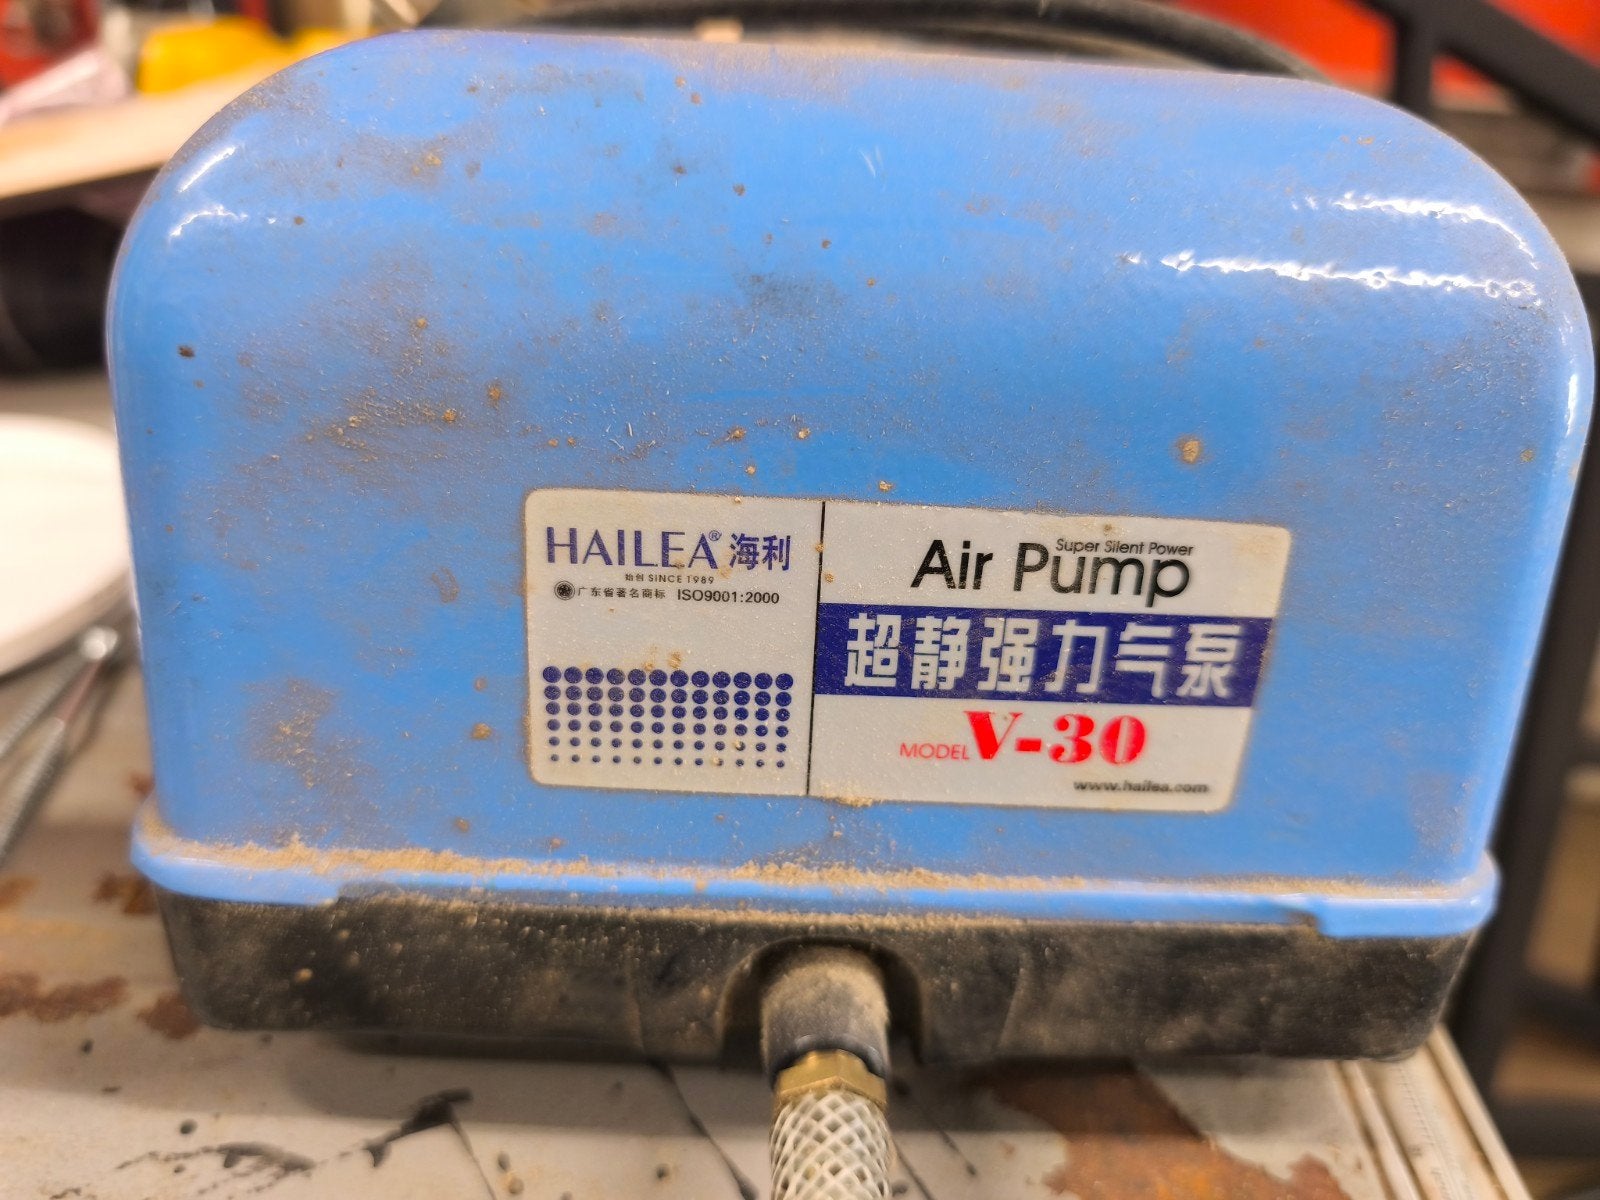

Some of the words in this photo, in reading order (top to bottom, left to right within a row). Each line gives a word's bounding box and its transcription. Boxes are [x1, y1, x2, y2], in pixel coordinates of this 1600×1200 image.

[729, 532, 791, 571] 海利
[1055, 538, 1100, 554] Super
[1104, 540, 1144, 554] Silent
[1148, 541, 1194, 556] Power
[648, 573, 682, 584] SINCE
[686, 575, 715, 585] 1989
[910, 539, 993, 590] Air
[1012, 542, 1190, 608] Pump
[677, 588, 780, 604] ISO9001:2000
[844, 612, 1241, 699] 超静强力气泵
[899, 742, 970, 760] MODEL
[963, 710, 1147, 765] V-30
[1073, 779, 1211, 793] www.hailea.com
